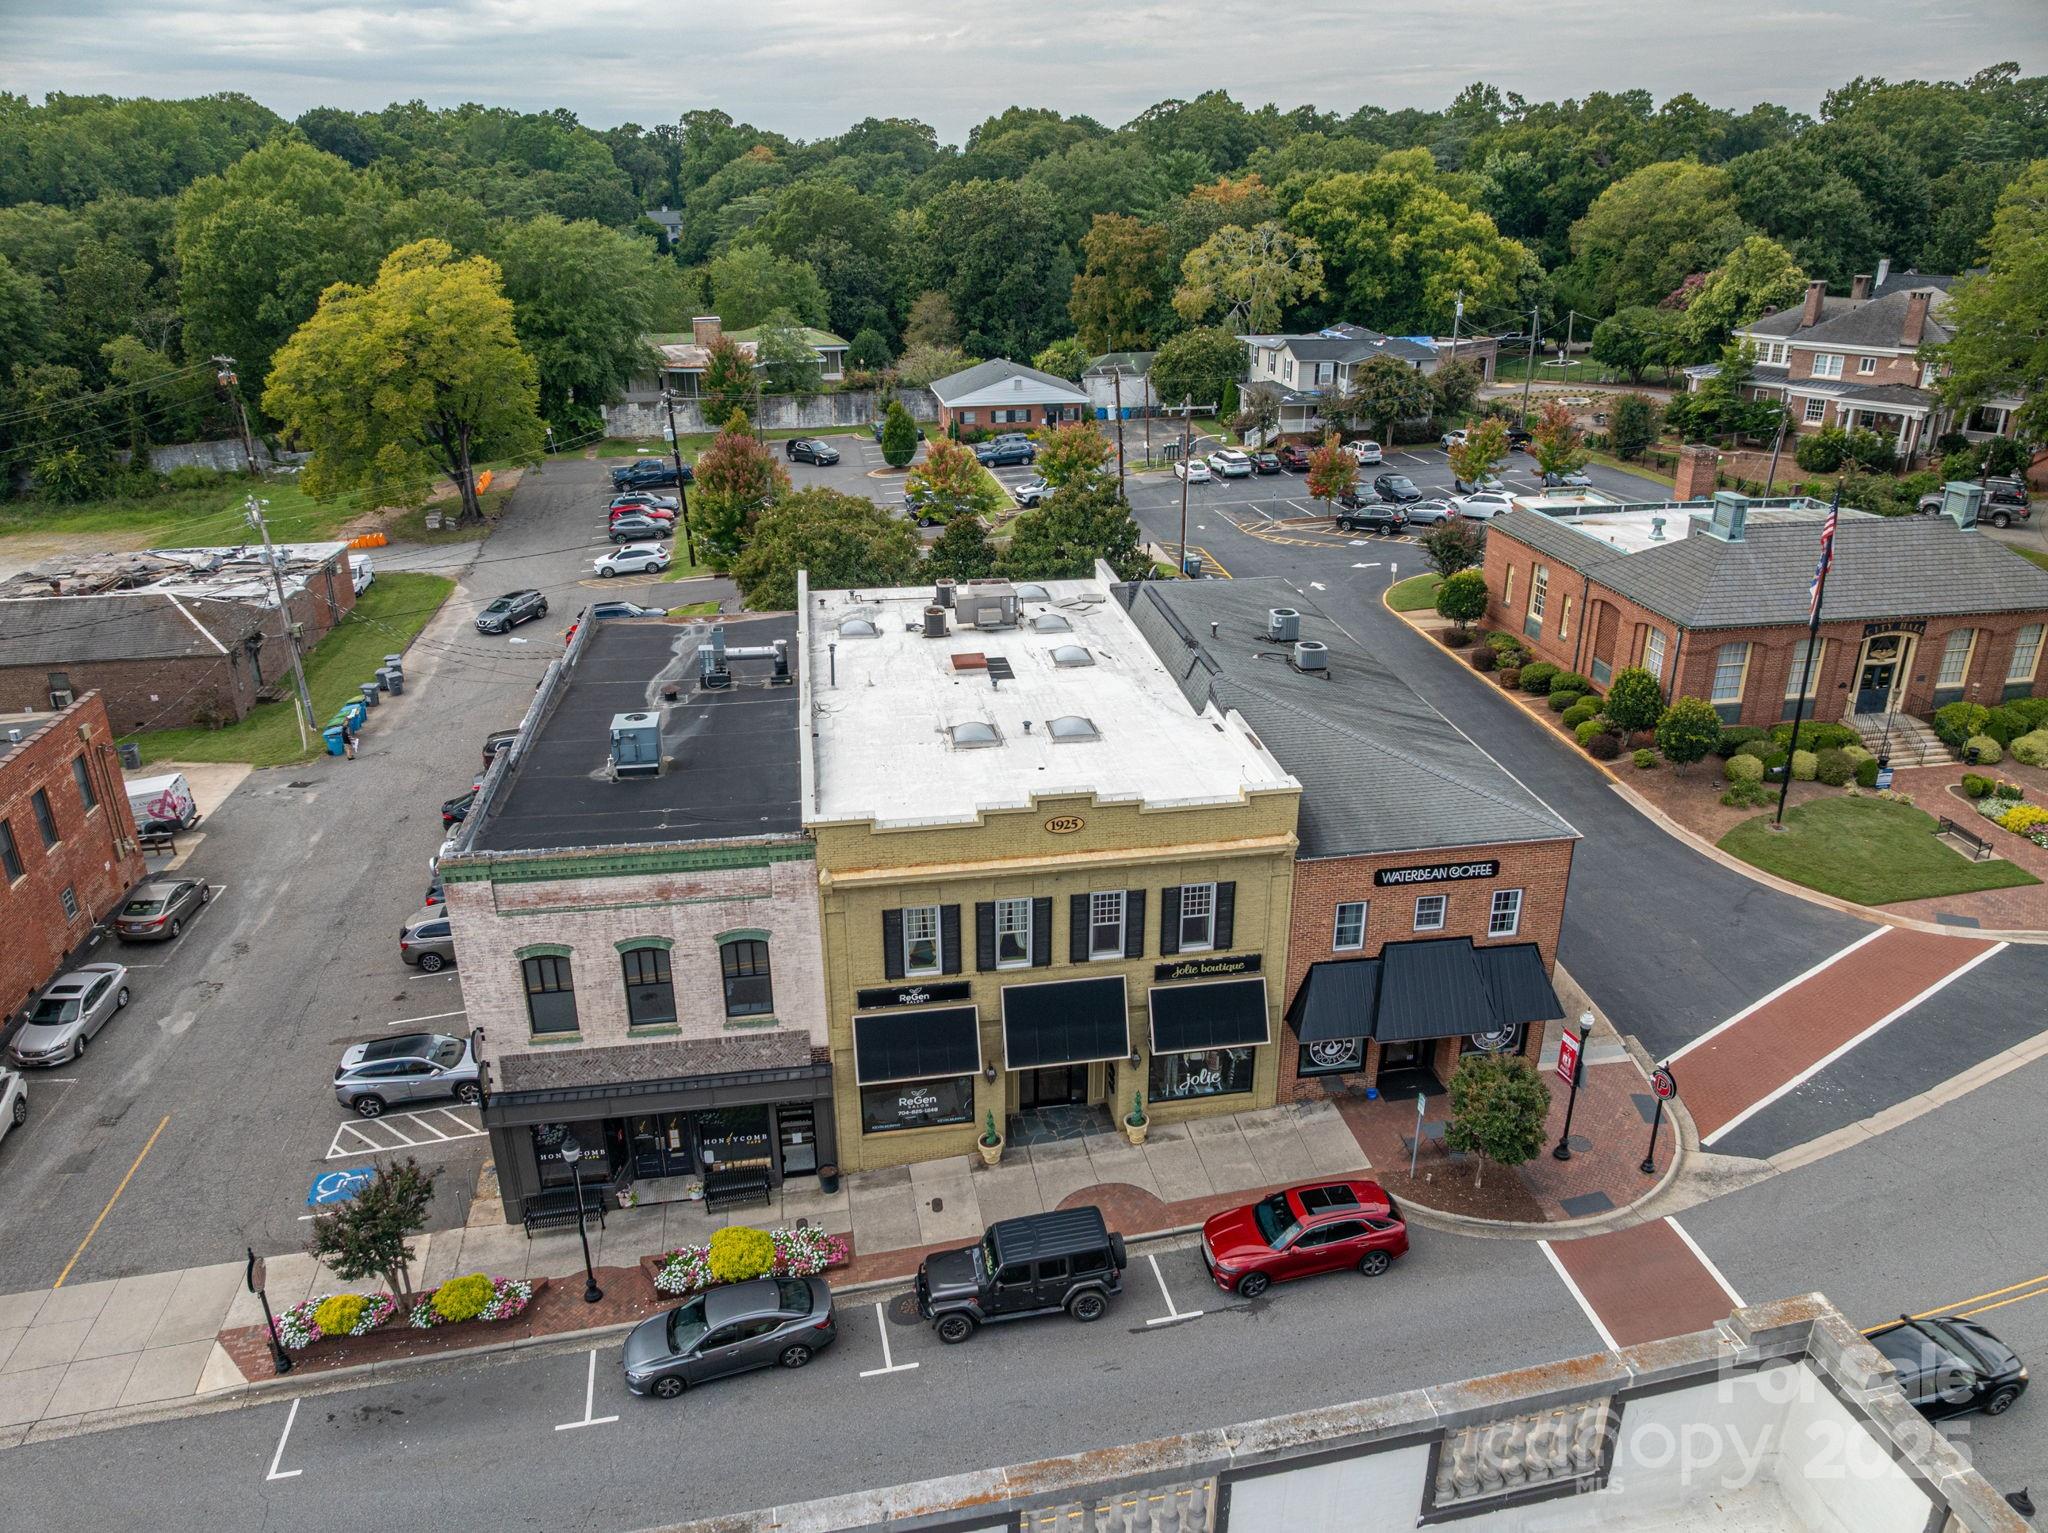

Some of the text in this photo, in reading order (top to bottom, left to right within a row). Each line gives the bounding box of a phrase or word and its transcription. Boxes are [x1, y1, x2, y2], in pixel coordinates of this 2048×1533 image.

[1866, 622, 1924, 635] CITY HALL
[1051, 819, 1078, 831] 1925
[1382, 863, 1493, 883] WATERBEAN COFFEE
[1172, 961, 1246, 978] jolie boutique
[899, 993, 930, 1003] ReGen
[1180, 1068, 1221, 1091] jolie
[898, 1096, 937, 1106] ReGen
[540, 1149, 606, 1160] HONCOMB
